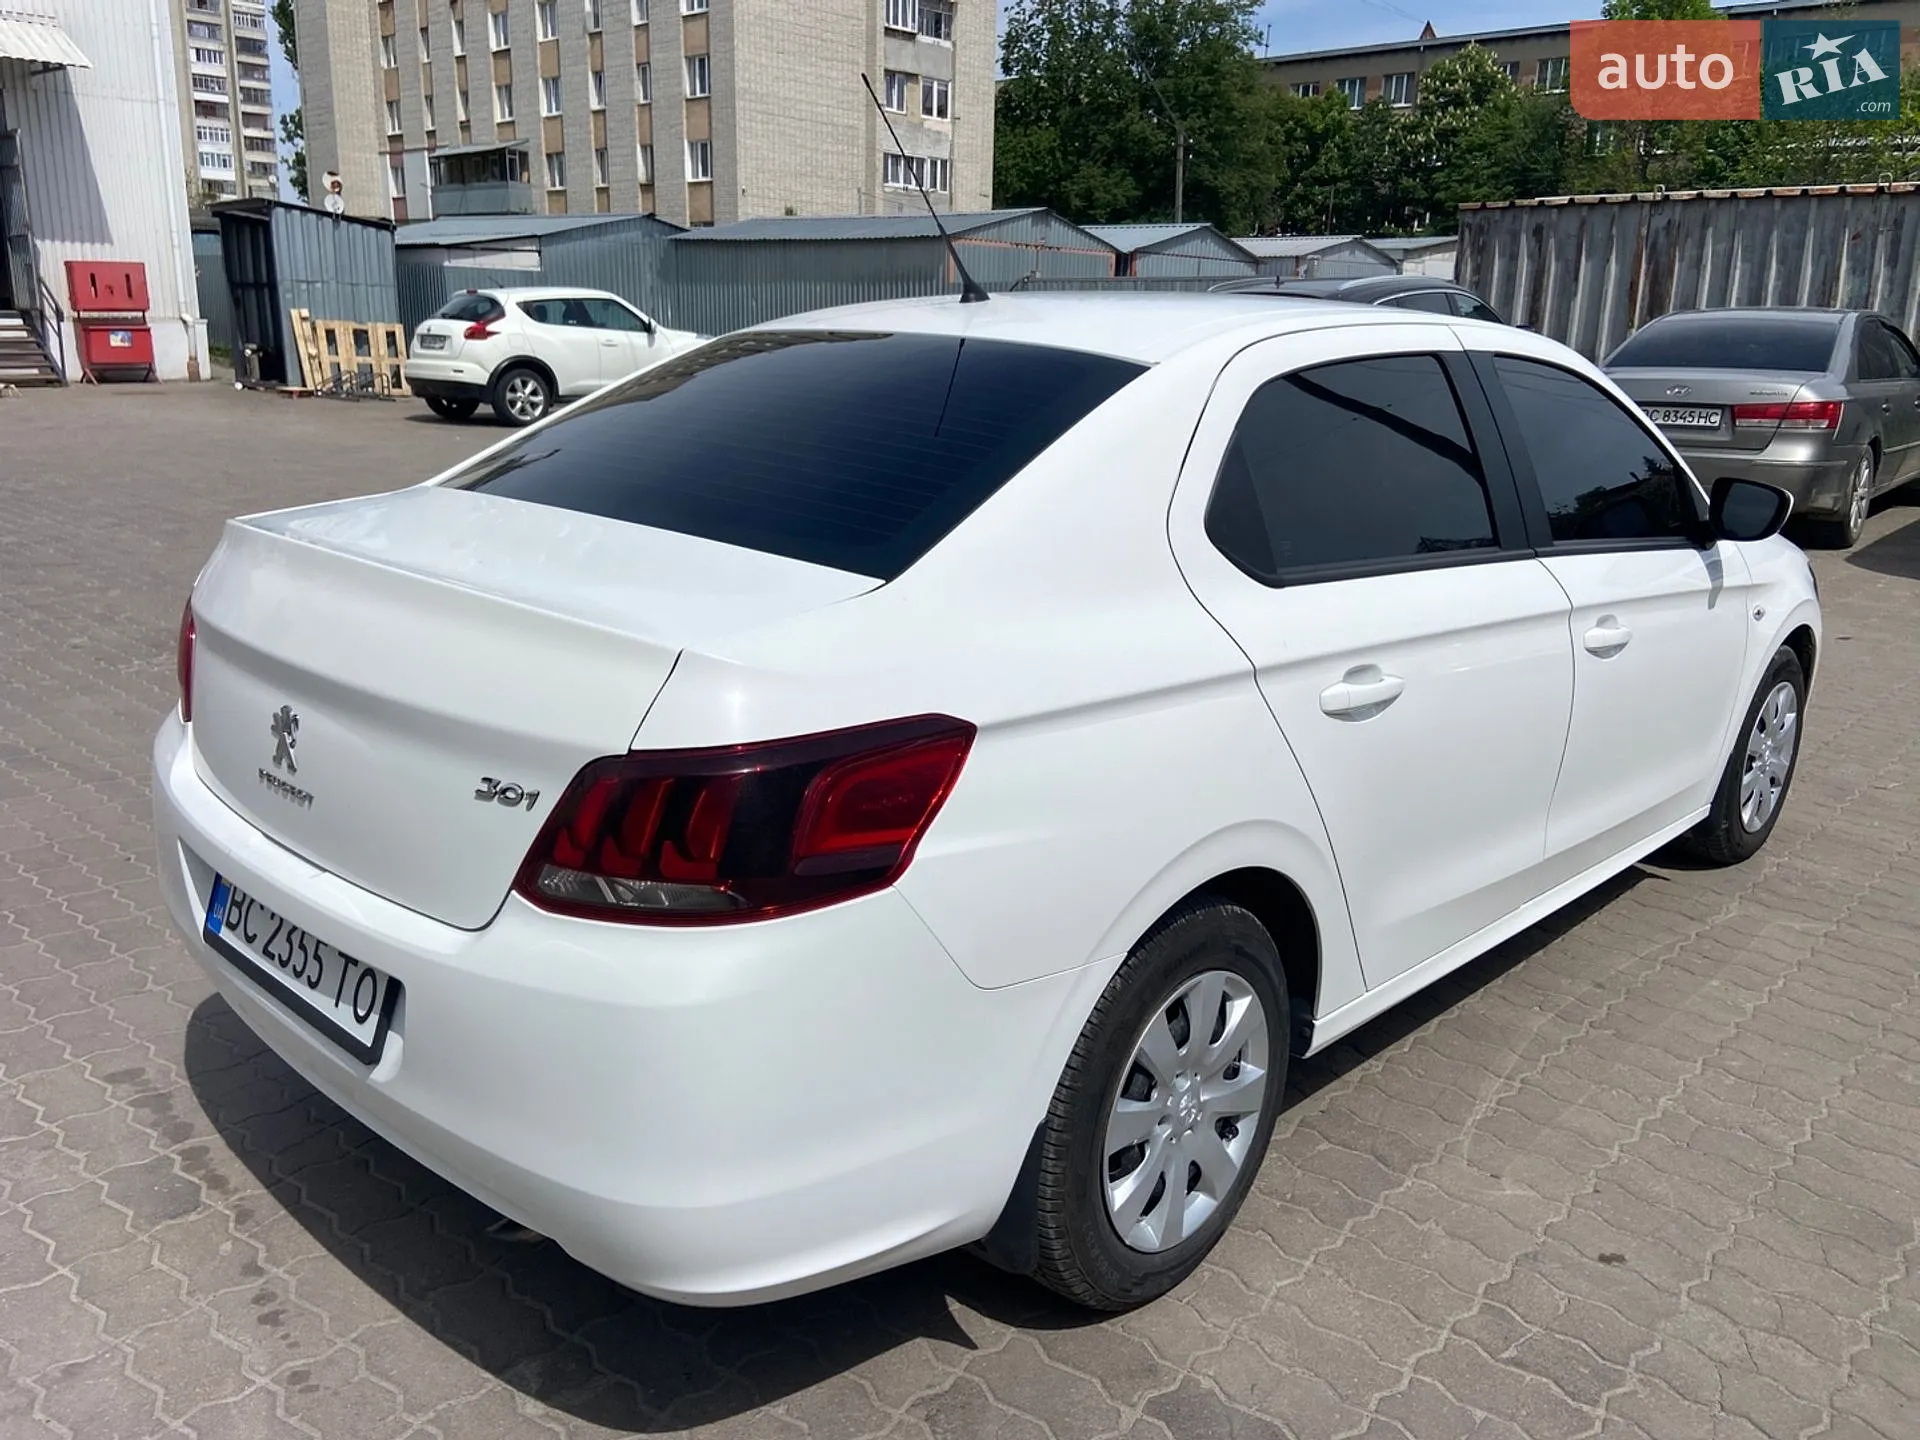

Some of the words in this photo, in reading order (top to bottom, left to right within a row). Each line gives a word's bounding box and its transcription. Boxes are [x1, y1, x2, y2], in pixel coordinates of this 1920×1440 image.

[1662, 409, 1695, 423] 8345
[1697, 411, 1719, 424] HC
[475, 777, 540, 812] 301
[225, 886, 264, 944] BC
[262, 912, 328, 990] 2355
[336, 951, 377, 1025] TO
